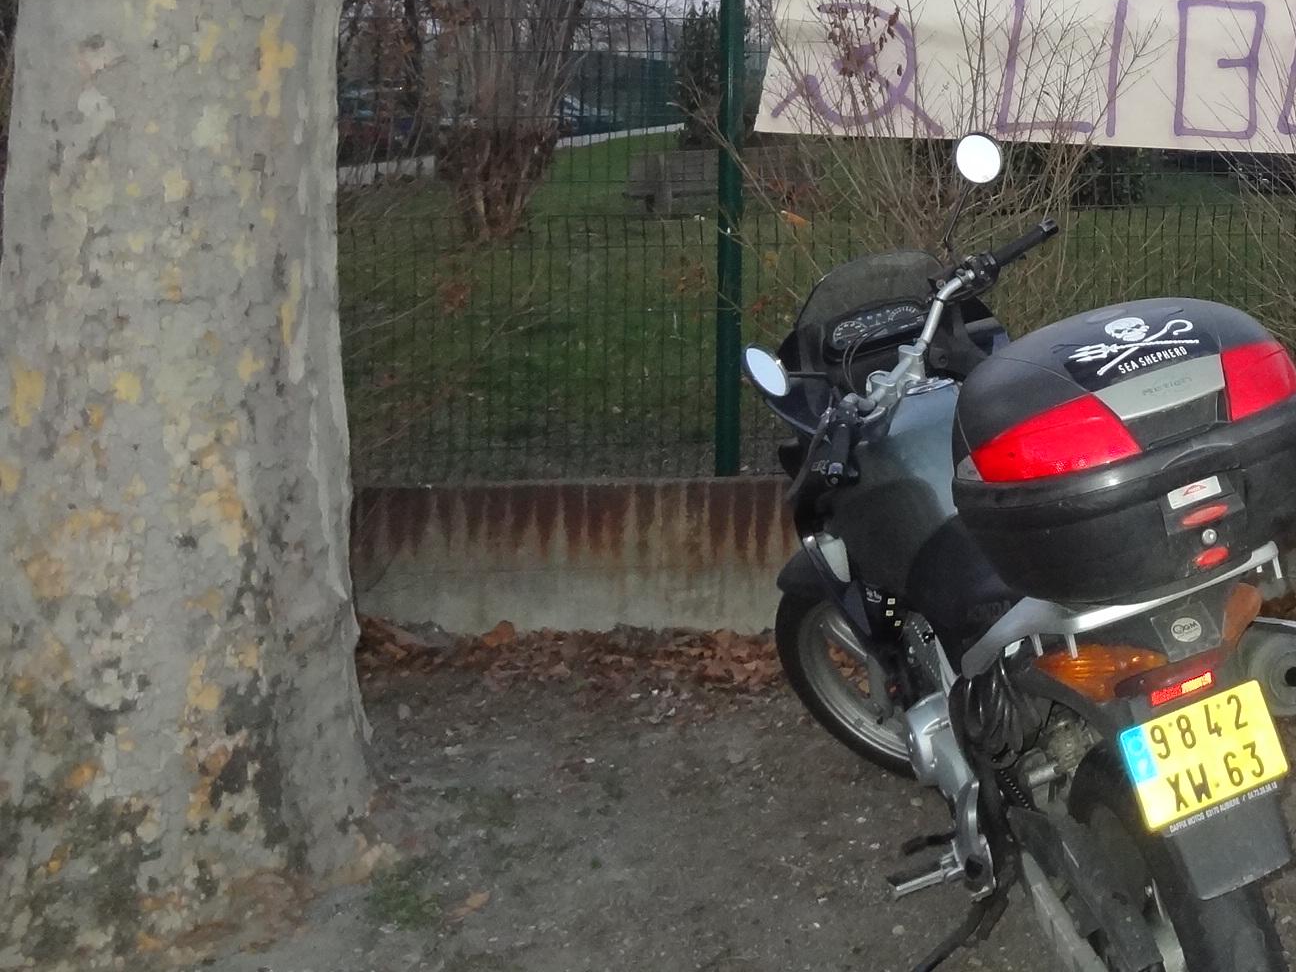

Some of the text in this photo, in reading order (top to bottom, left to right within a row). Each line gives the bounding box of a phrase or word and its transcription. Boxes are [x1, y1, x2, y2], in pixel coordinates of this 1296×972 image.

[1118, 346, 1188, 374] SEA SHEPHERD
[1150, 694, 1249, 760] 9842
[1166, 740, 1265, 813] XW 63
